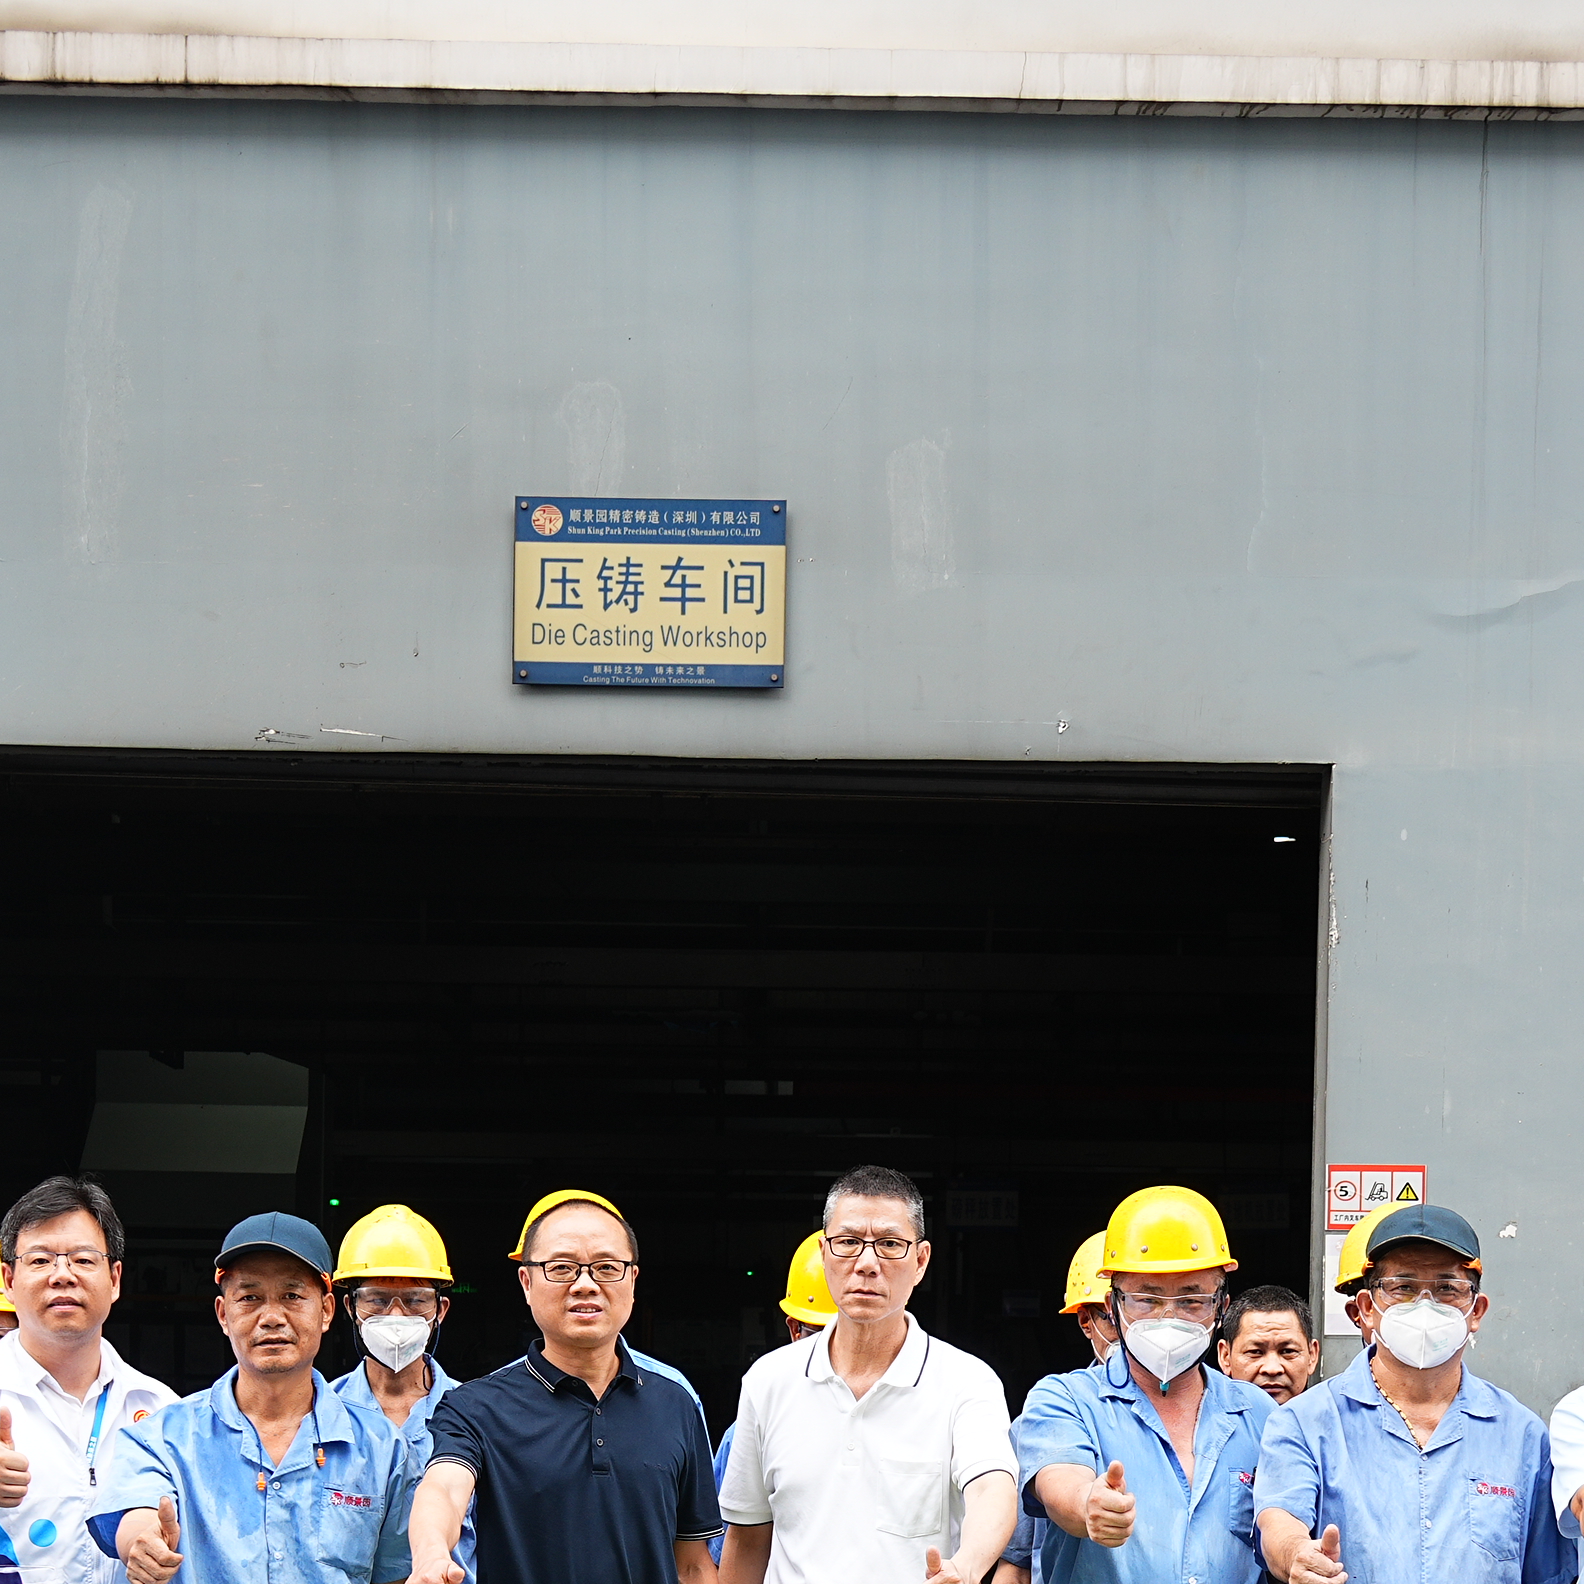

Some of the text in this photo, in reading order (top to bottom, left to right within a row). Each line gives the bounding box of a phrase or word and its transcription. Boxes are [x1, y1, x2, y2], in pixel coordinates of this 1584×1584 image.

[569, 508, 760, 525] 顺景园精密铸造（深圳）有限公司
[567, 527, 586, 535] Shun
[587, 527, 605, 536] King
[605, 527, 622, 536] Park
[623, 527, 657, 536] Precision
[657, 528, 687, 537] Casting
[687, 528, 729, 538] (Shenzhen)
[535, 556, 766, 616] 压铸车间
[531, 623, 768, 653] Die Casting Workshop
[592, 665, 706, 675] 顺科技之势 铸未来之景
[583, 675, 610, 685] Casting
[611, 676, 625, 684] The
[626, 676, 649, 684] Future
[1339, 1185, 1349, 1197] 5
